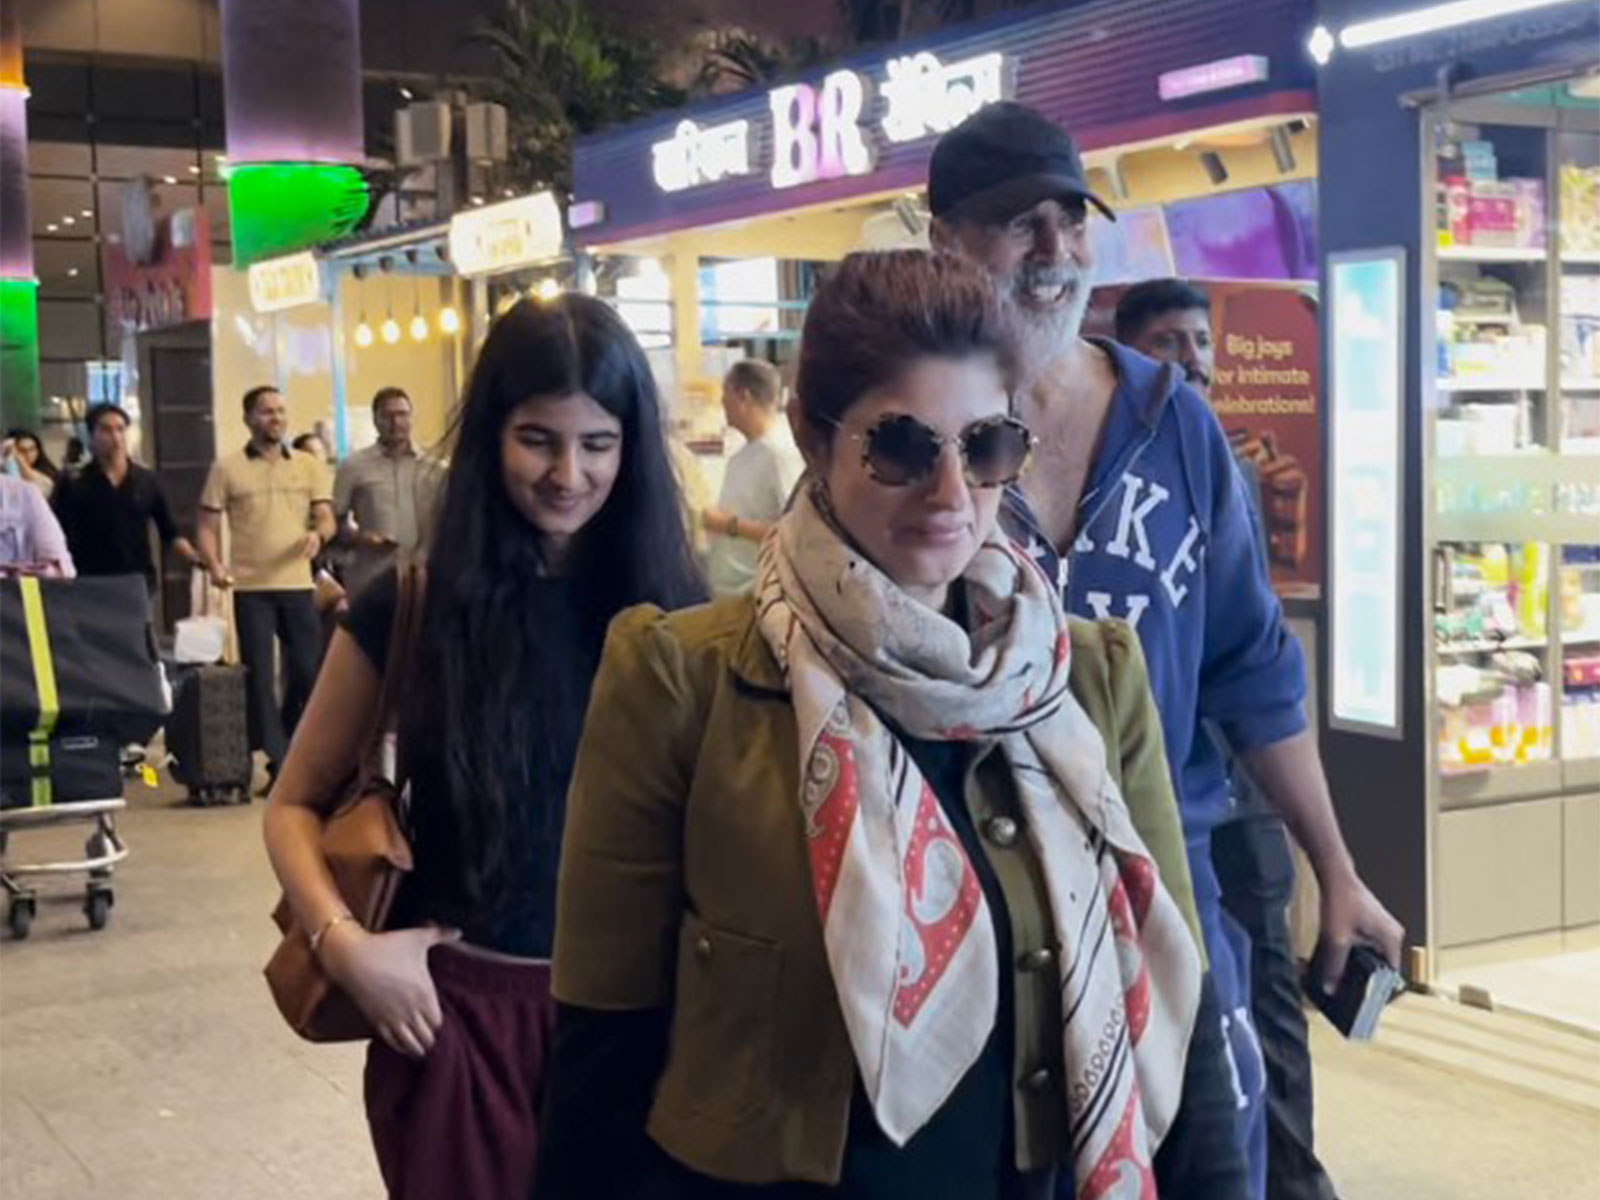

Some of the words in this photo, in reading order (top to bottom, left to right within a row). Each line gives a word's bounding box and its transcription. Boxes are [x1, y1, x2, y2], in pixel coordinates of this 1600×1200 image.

[768, 69, 871, 189] BR
[1226, 333, 1255, 361] Big
[1254, 333, 1294, 361] joys
[1212, 370, 1235, 386] or
[1237, 365, 1310, 386] intimate
[1212, 393, 1317, 414] elebrations!
